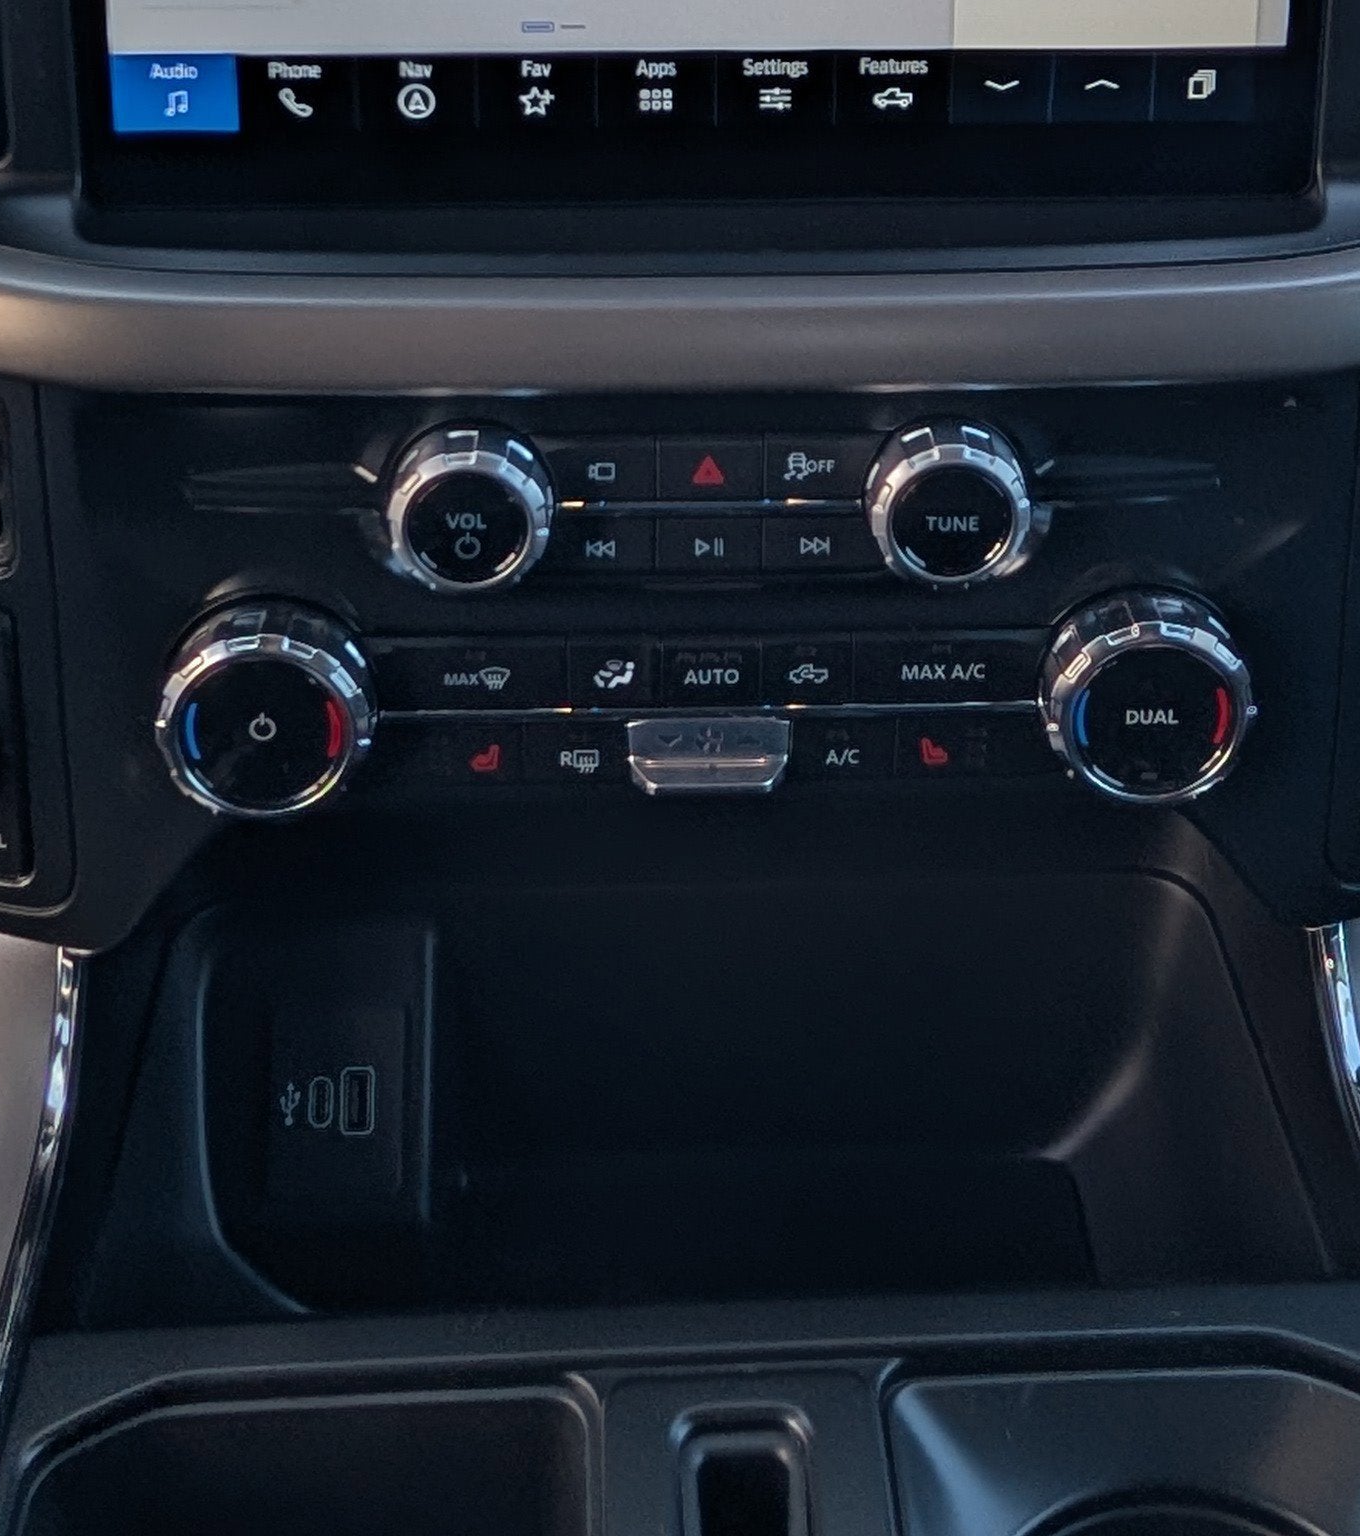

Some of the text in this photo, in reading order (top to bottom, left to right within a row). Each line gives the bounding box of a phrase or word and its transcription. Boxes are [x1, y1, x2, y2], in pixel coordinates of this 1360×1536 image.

[149, 62, 198, 80] Audio
[267, 61, 322, 79] Phone
[399, 61, 433, 78] Nav
[521, 59, 552, 78] Fav
[635, 59, 678, 79] Apps
[742, 58, 809, 79] Settings
[859, 56, 929, 75] Features
[806, 458, 836, 474] OFF
[445, 512, 487, 530] VOL
[925, 515, 980, 532] TUNE
[443, 672, 480, 686] MAX
[684, 668, 740, 685] AUTO
[901, 662, 986, 681] MAX A/C
[1125, 708, 1179, 725] DUAL
[560, 749, 575, 768] R
[825, 748, 860, 766] A/C
